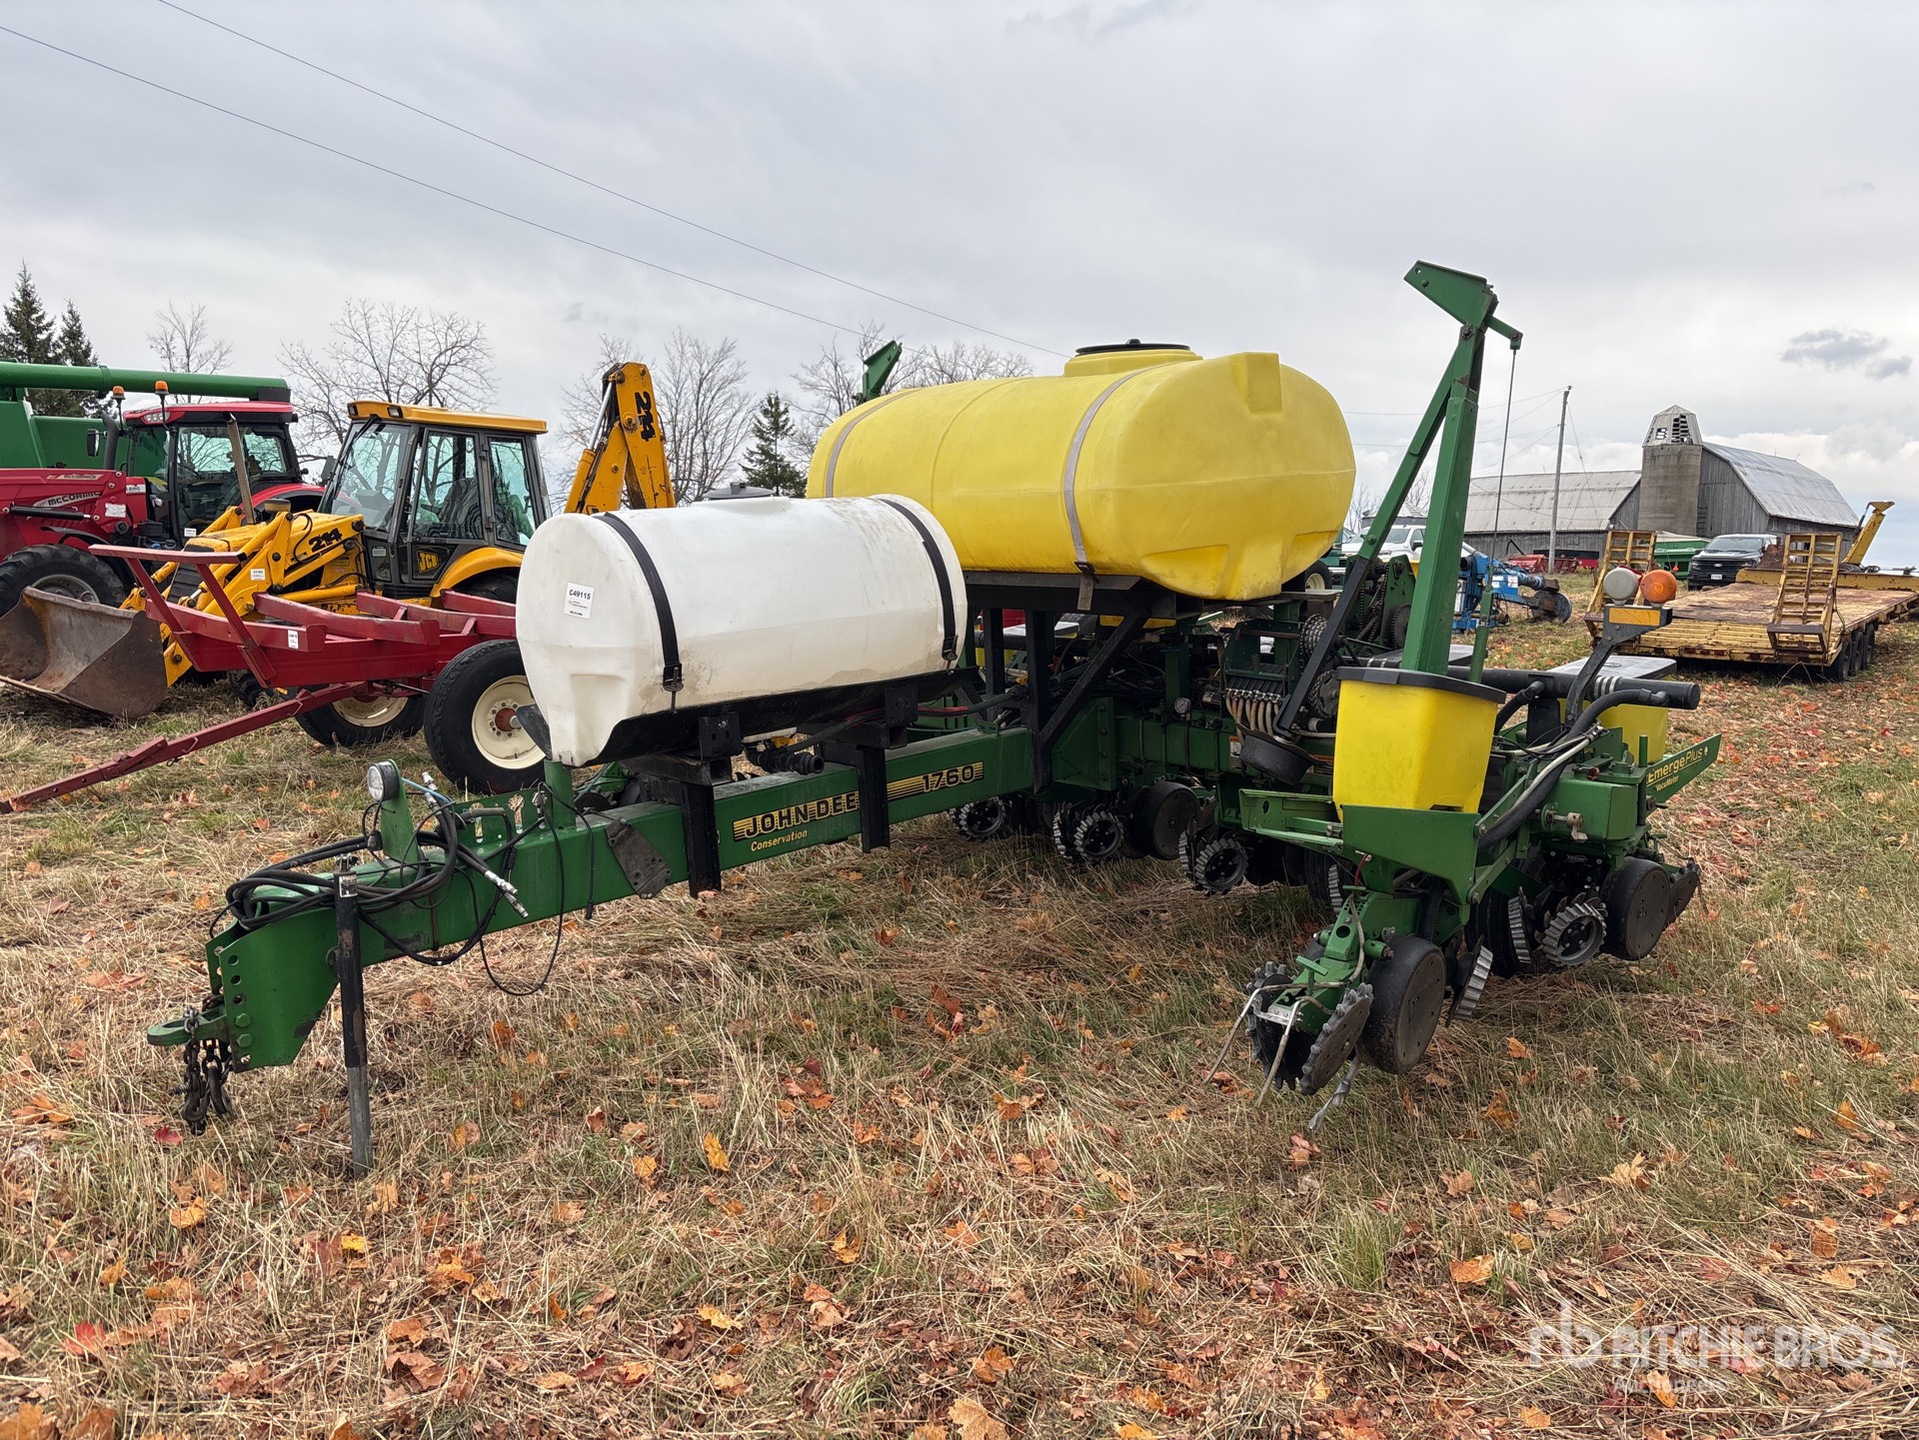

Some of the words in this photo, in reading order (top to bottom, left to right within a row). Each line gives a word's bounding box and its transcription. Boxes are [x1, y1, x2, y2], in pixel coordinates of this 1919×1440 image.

[634, 390, 656, 442] 214
[308, 528, 343, 553] 214
[419, 551, 438, 572] JCB
[568, 589, 591, 600] C49115
[922, 764, 977, 792] 1760
[744, 805, 810, 838] JOHN
[816, 791, 860, 819] DEE
[751, 828, 808, 852] Conservation
